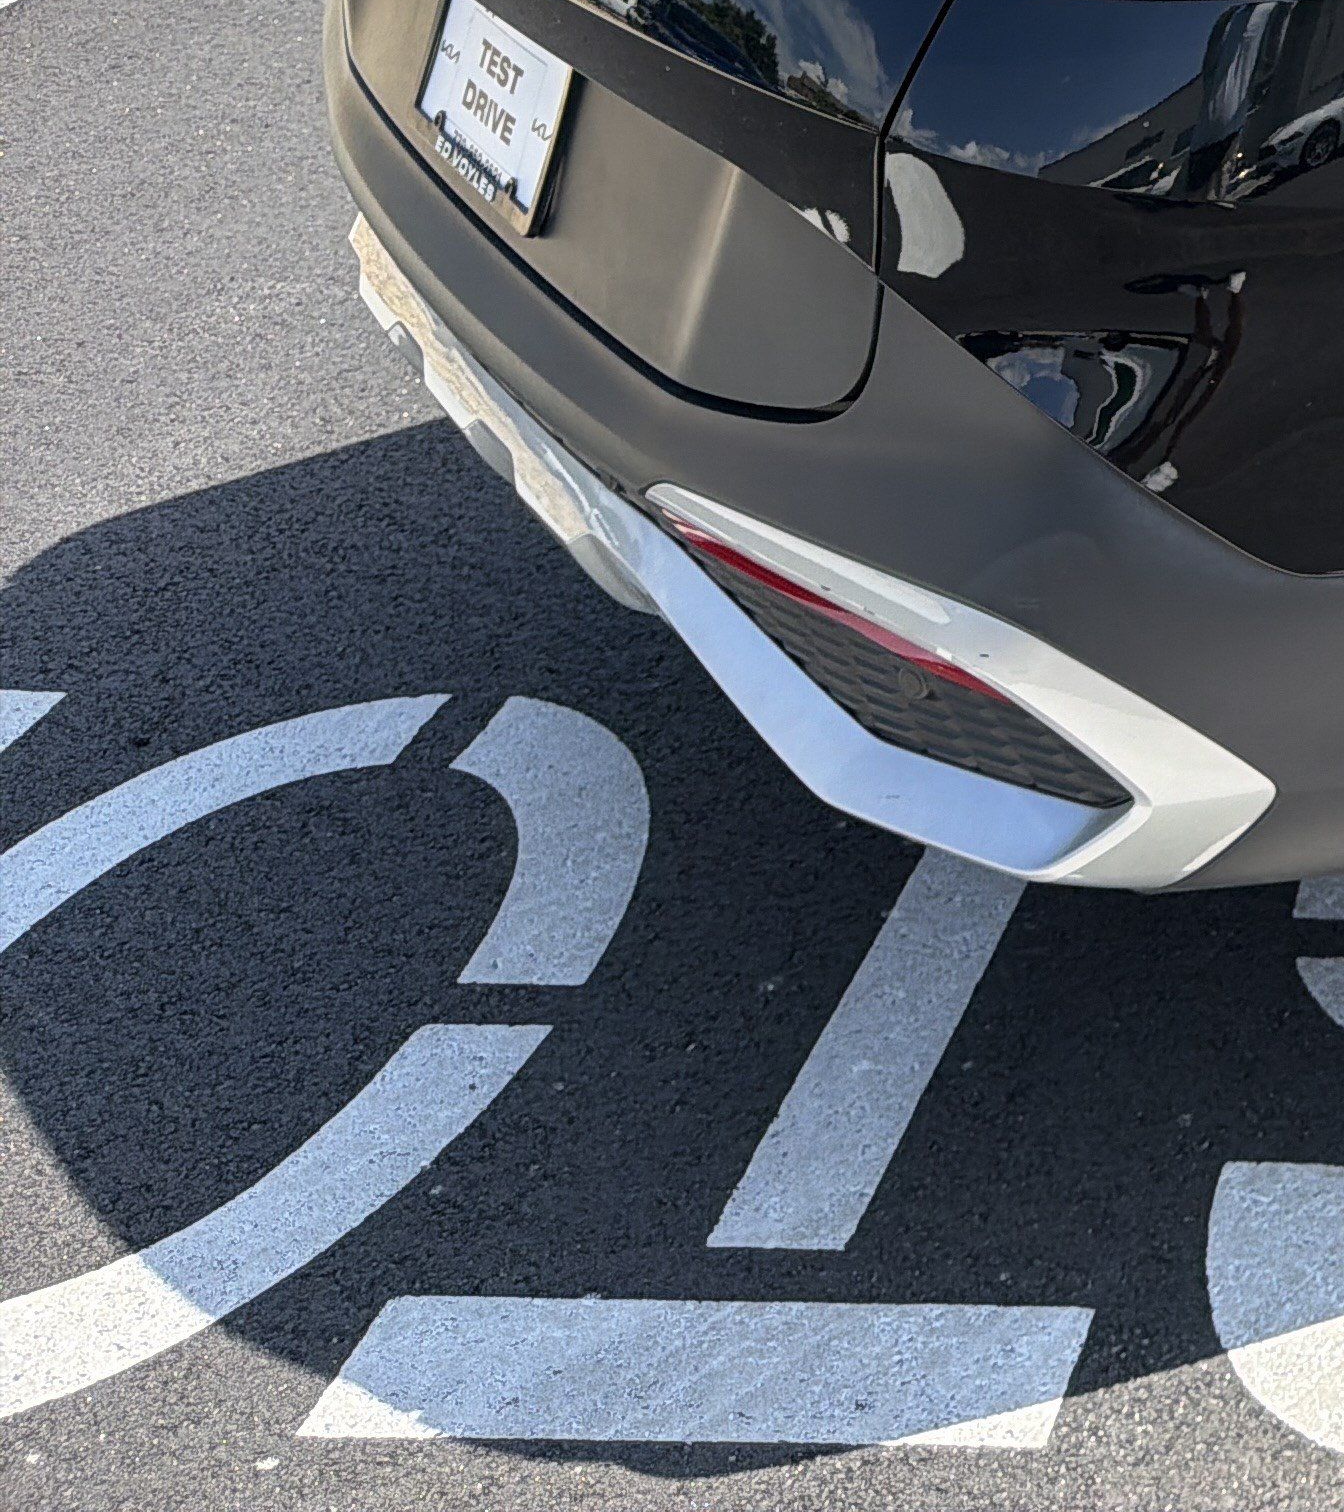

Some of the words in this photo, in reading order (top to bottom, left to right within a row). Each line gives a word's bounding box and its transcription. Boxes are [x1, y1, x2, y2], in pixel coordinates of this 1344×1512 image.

[479, 38, 524, 94] TEST
[462, 79, 516, 146] DRIVE
[435, 134, 452, 159] ED
